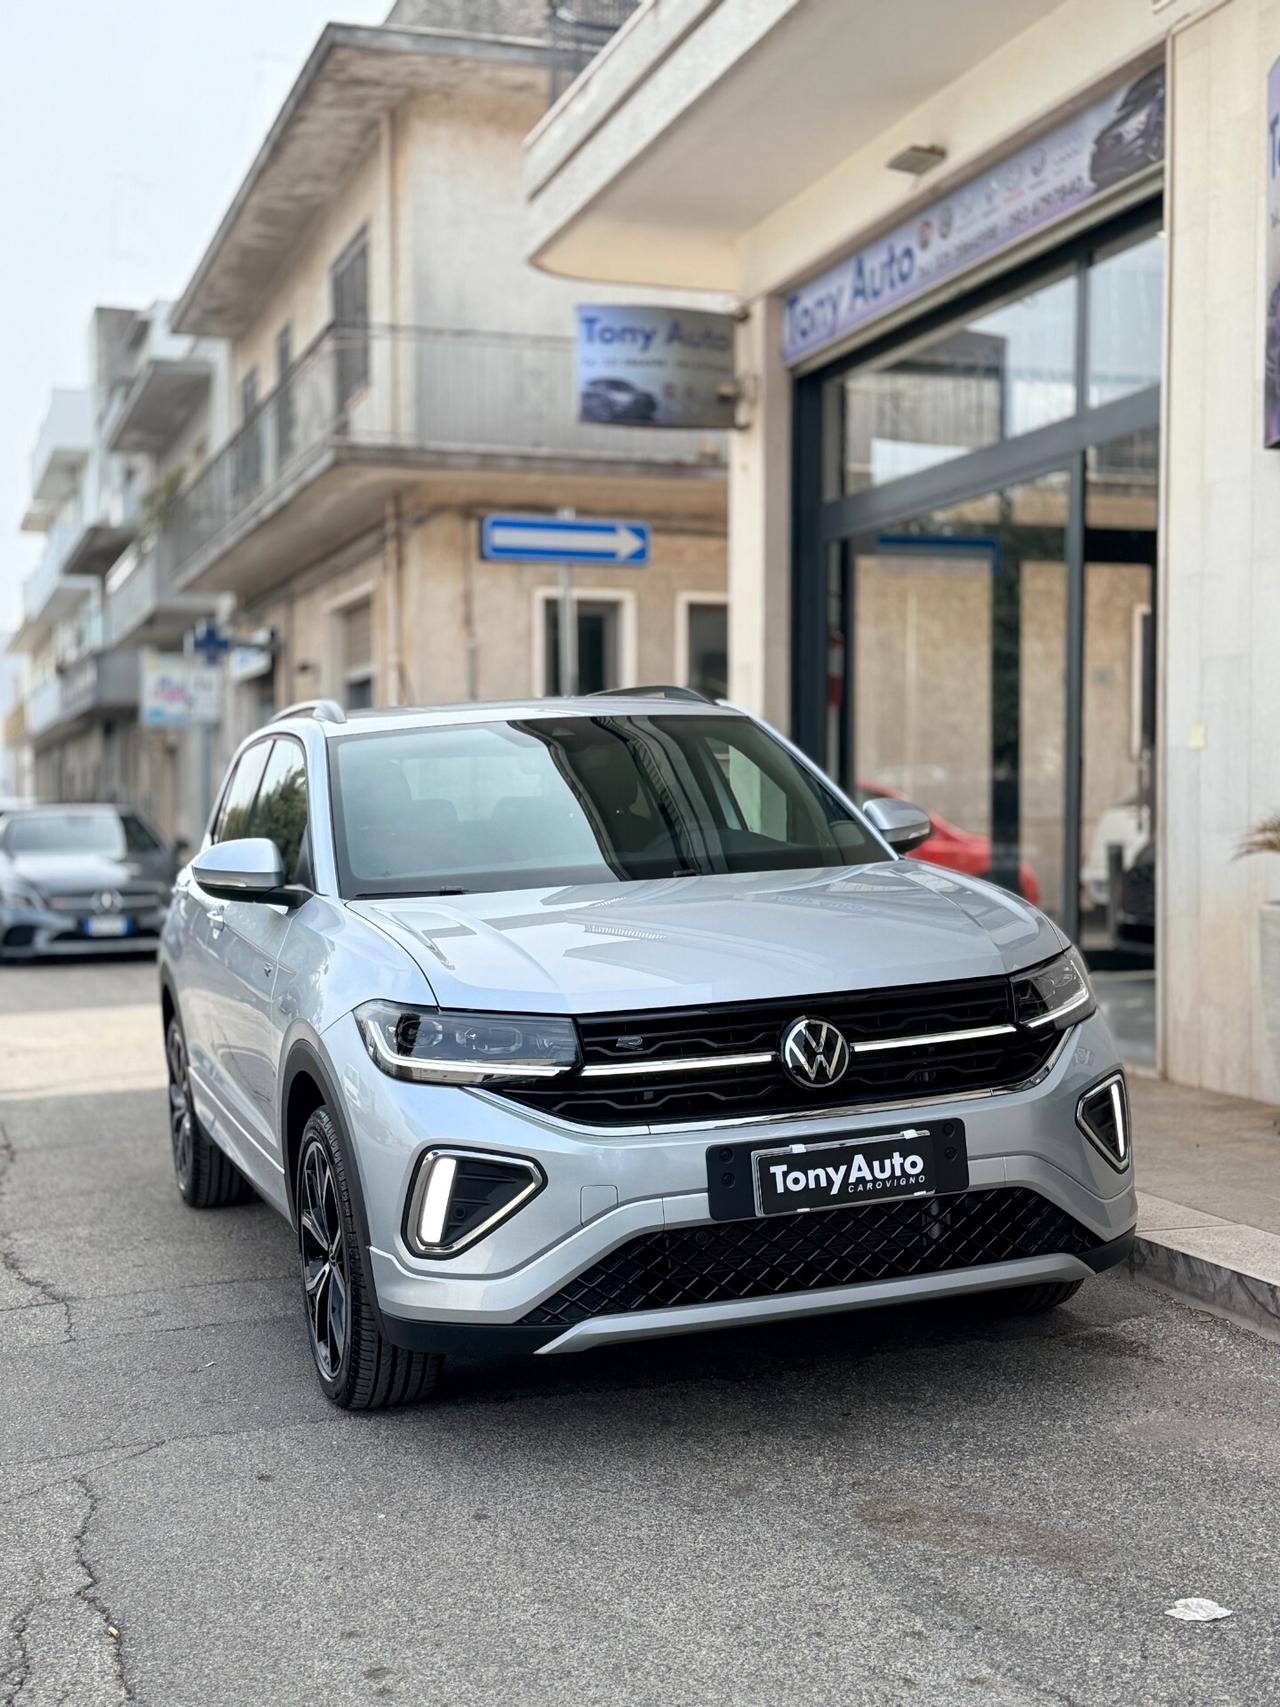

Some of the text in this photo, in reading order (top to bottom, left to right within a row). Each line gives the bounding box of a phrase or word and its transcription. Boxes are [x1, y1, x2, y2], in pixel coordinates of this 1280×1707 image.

[785, 284, 845, 343] Tony
[847, 243, 915, 312] Auto
[580, 317, 731, 351] Tony Auto
[848, 1174, 926, 1193] CAROVIGNO
